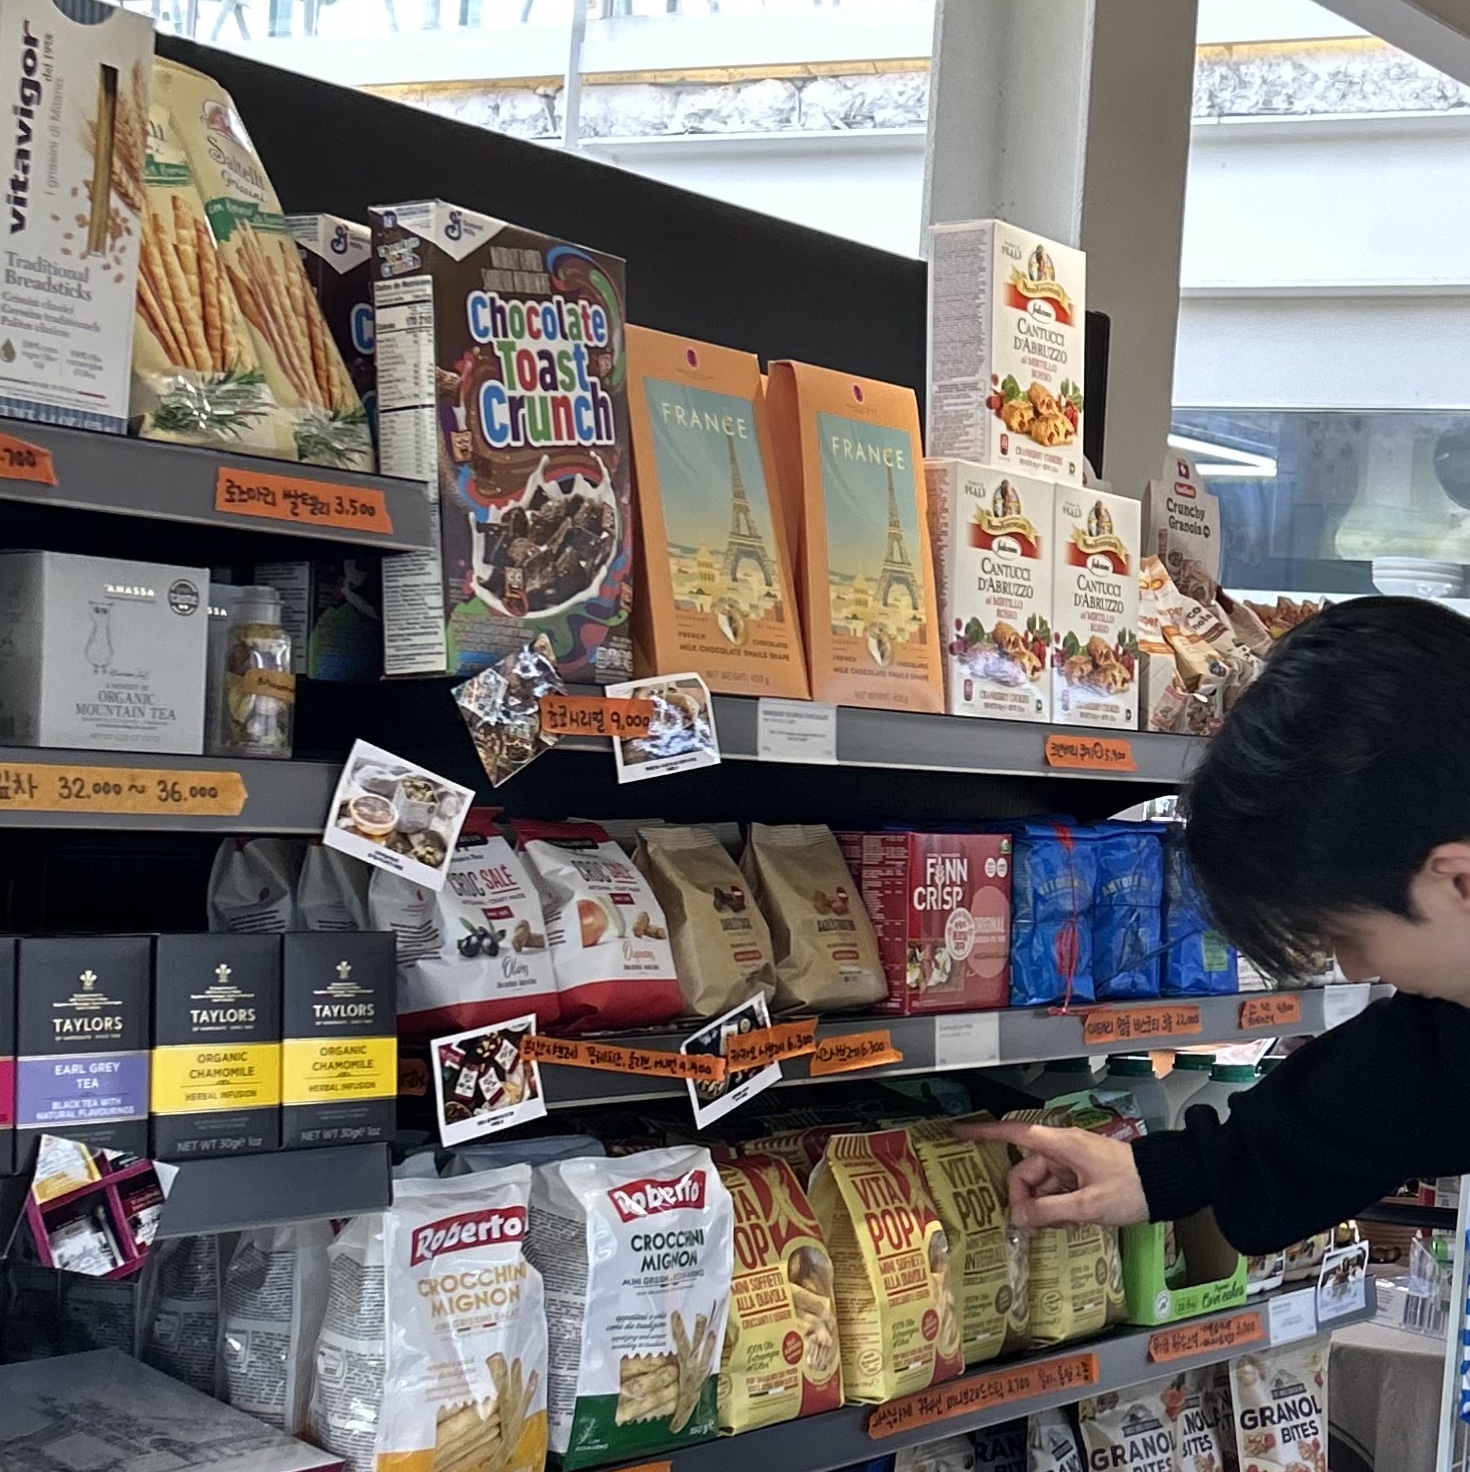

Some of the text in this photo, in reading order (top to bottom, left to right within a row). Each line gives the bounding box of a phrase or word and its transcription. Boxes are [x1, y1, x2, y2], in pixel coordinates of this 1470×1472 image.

[10, 20, 42, 235] vitavigor
[5, 251, 90, 283] Traditional
[4, 270, 92, 301] Breadsticks
[468, 291, 607, 346] Chocolate
[1017, 317, 1065, 347] CANTUCCI
[1013, 335, 1067, 364] D'ABRUZZO
[494, 340, 591, 394] Toast
[480, 378, 615, 447] Crunch
[661, 402, 749, 440] FRANCE
[831, 436, 905, 470] FRANCE
[1166, 498, 1206, 522] Crunchy
[981, 557, 1030, 582] CANTUCCI
[978, 576, 1033, 599] D'ABRUZZO
[1077, 574, 1121, 597] CANTUCCI
[1074, 592, 1124, 614] D'ABRUZZO
[98, 690, 156, 706] ORGANIC
[75, 703, 176, 721] MOUNTAIN TEA
[926, 858, 968, 885] FINN
[913, 886, 963, 911] CRISP
[191, 1008, 256, 1026] TAYLORS
[313, 1003, 375, 1020] TAYLORS
[53, 1016, 123, 1035] TAYLORS
[197, 1051, 248, 1064] ORGANIC
[320, 1045, 368, 1057] ORGANIC
[55, 1061, 121, 1076] EARL GREY
[189, 1067, 255, 1080] CHAMOMILE
[312, 1059, 374, 1072] CHAMOMILE
[77, 1078, 99, 1090] TEA
[186, 1088, 257, 1103] HERBAL INFUSION
[309, 1081, 376, 1093] HERBAL INFUSION
[36, 1106, 135, 1121] NATURAL FLAVOURINGS
[52, 1096, 122, 1110] BLACK TEA WITH
[301, 1128, 338, 1141] NET WT
[939, 1154, 988, 1190] VITA
[613, 1177, 700, 1216] Roberto
[851, 1174, 903, 1211] VITA
[952, 1187, 996, 1231] POP
[415, 1210, 526, 1259] Roberto
[631, 1229, 704, 1251] CROCCHINI
[864, 1206, 915, 1255] POP
[735, 1223, 769, 1270] OP
[641, 1250, 698, 1273] MIGNON
[750, 1272, 784, 1291] SOFFIETTI
[431, 1286, 521, 1318] MIGNON
[736, 1290, 788, 1313] ALLA DIAVOLA
[1281, 1420, 1319, 1445] BITES
